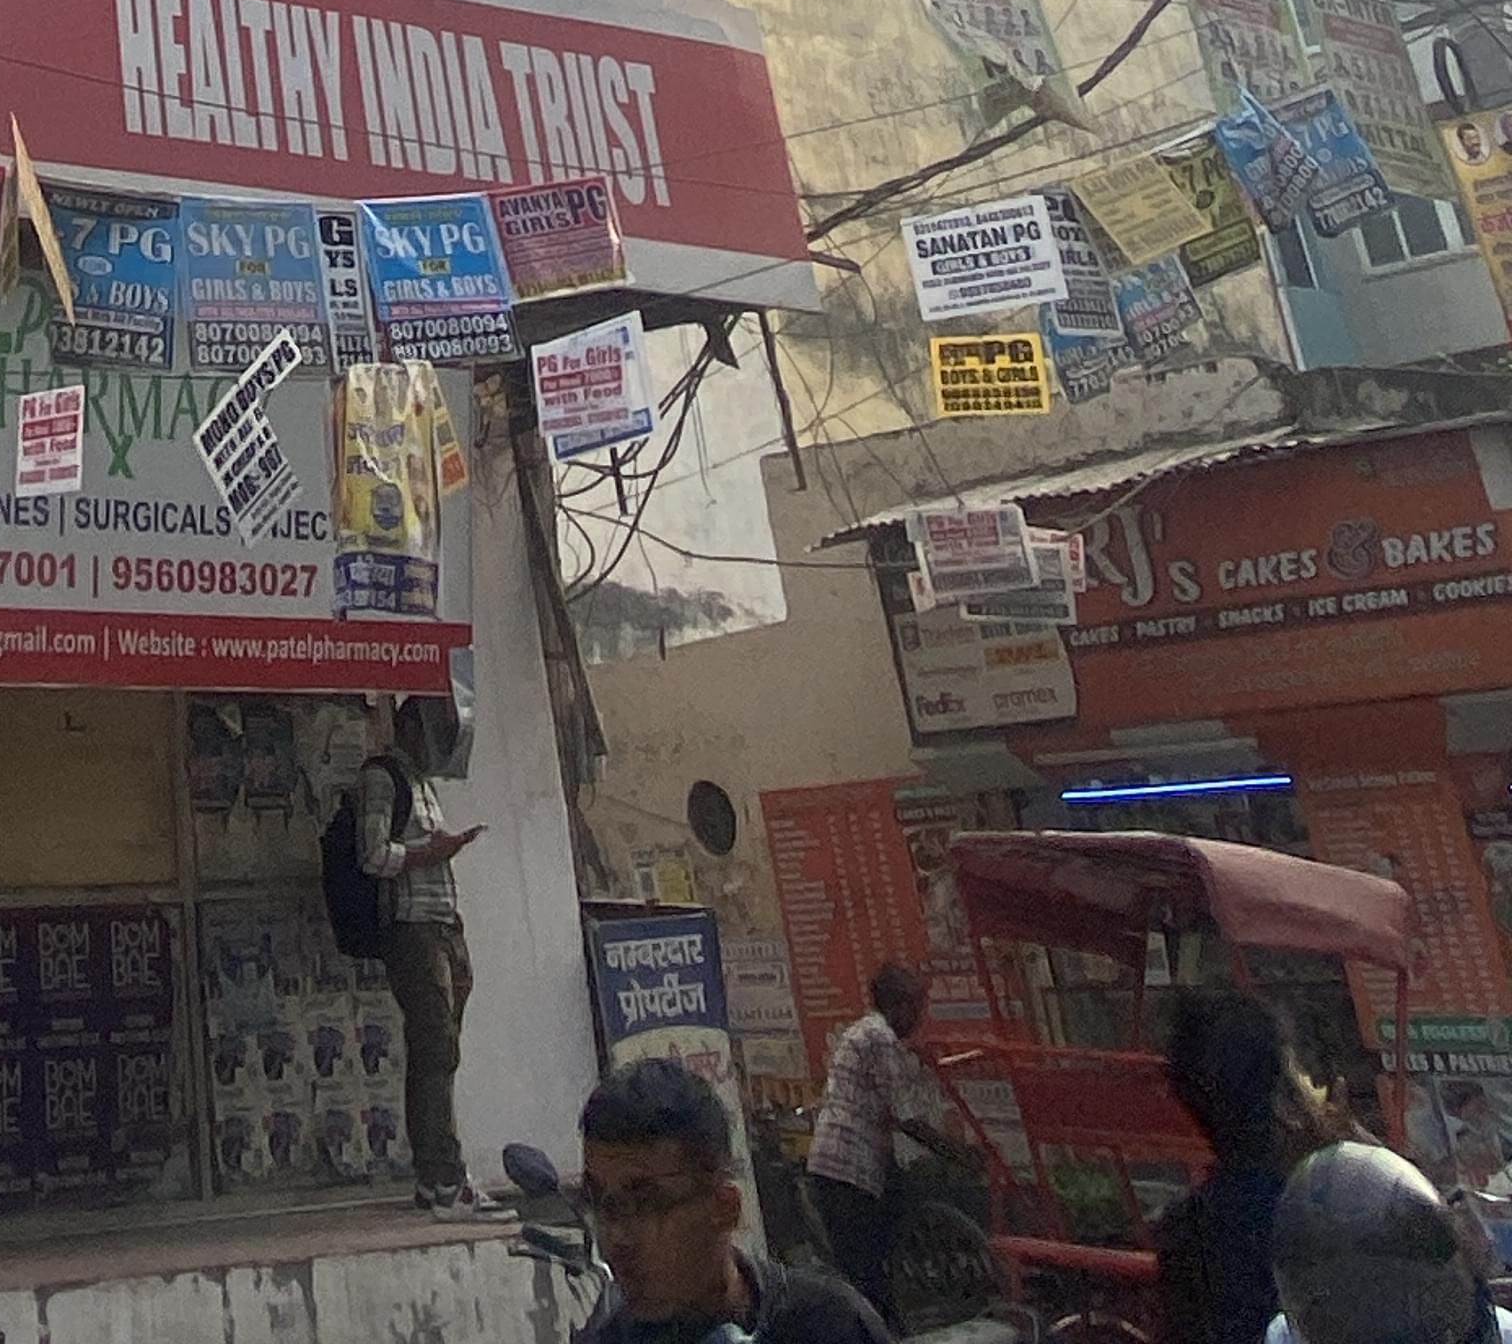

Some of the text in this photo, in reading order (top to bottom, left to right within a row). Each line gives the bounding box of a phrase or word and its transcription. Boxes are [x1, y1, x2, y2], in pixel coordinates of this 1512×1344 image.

[351, 13, 514, 185] INDIA
[497, 40, 674, 208] TRUST
[500, 183, 607, 223] AVANYA PG
[107, 221, 175, 265] PG
[188, 220, 310, 259] SKY PG
[374, 221, 486, 259] SKY PG
[505, 211, 573, 237] GIRLS
[915, 224, 1008, 260] SANATAN
[1012, 220, 1042, 243] PG
[107, 280, 170, 312] BOYS
[192, 279, 317, 303] GIRLS & BOYS
[383, 274, 499, 301] GIRLS & BOYS
[389, 313, 509, 342] 8070080094
[537, 345, 622, 376] PG Girls
[583, 383, 623, 402] Food
[73, 496, 232, 535] SURGICALS
[1218, 548, 1320, 591] CAKES
[1381, 520, 1497, 570] BAKES
[111, 554, 319, 599] 9560983027
[1070, 588, 1411, 648] CAKES PASTRY SNACKS ICE CREAM
[118, 629, 196, 658] Website
[211, 633, 442, 668] www.patelpharmacy.com
